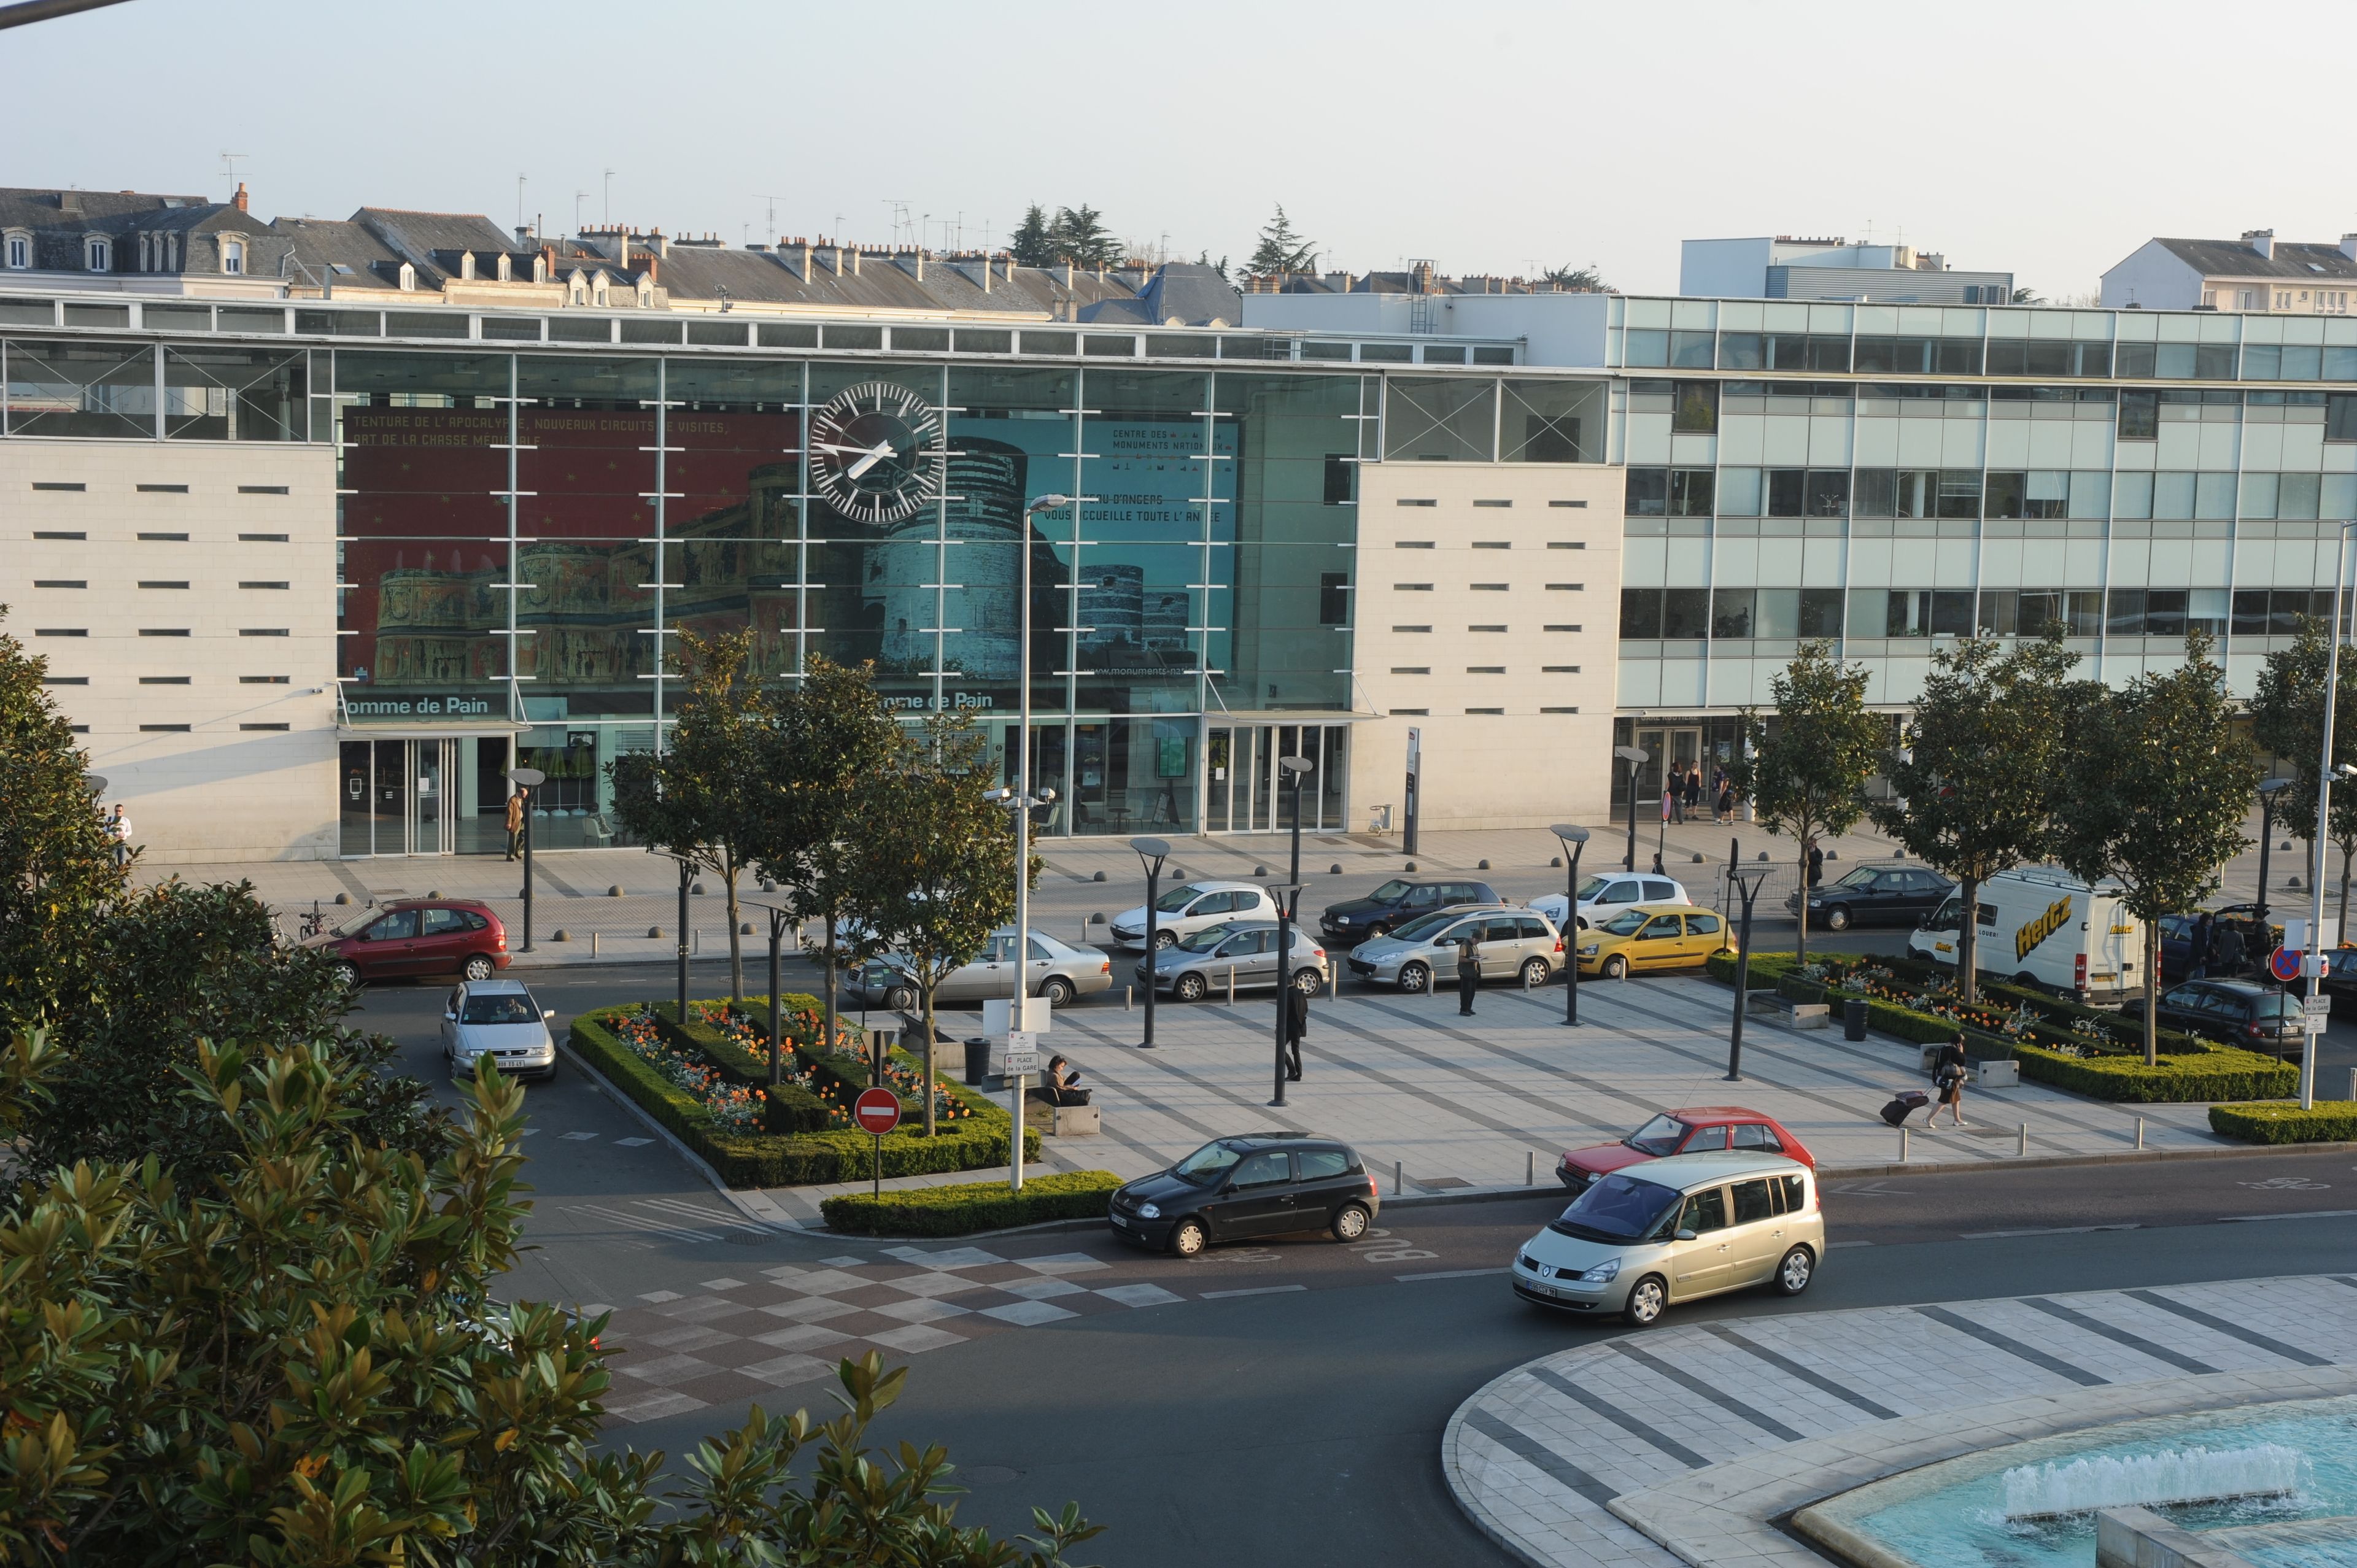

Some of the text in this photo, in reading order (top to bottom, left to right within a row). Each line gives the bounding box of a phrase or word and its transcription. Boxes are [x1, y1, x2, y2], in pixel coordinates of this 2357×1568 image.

[353, 415, 409, 428] TENTURE
[415, 415, 430, 428] DE
[435, 416, 445, 428] L'
[449, 417, 529, 431] APOCALYPE,
[535, 418, 595, 430] NOUVEAUX
[601, 419, 654, 431] CIRCUITS
[678, 422, 729, 434] VISITES,
[353, 433, 376, 445] ART
[382, 434, 397, 445] DE
[403, 434, 416, 445] LA
[422, 434, 468, 446] CHASSE
[1113, 430, 1167, 439] CENTRE DES
[1113, 440, 1223, 450] MONUMENTS NATIONUX
[1113, 494, 1163, 504] D'ANGERS
[1044, 509, 1071, 520] VOUS
[1136, 511, 1170, 522] TOUTE
[1174, 511, 1183, 522] L'
[338, 697, 489, 714] Pomme de Pain
[954, 692, 993, 708] Pain
[1978, 929, 1999, 938] LOUER!
[2016, 894, 2072, 964] Hertz
[2110, 925, 2134, 935] Hertz
[1935, 941, 1953, 953] Hertz
